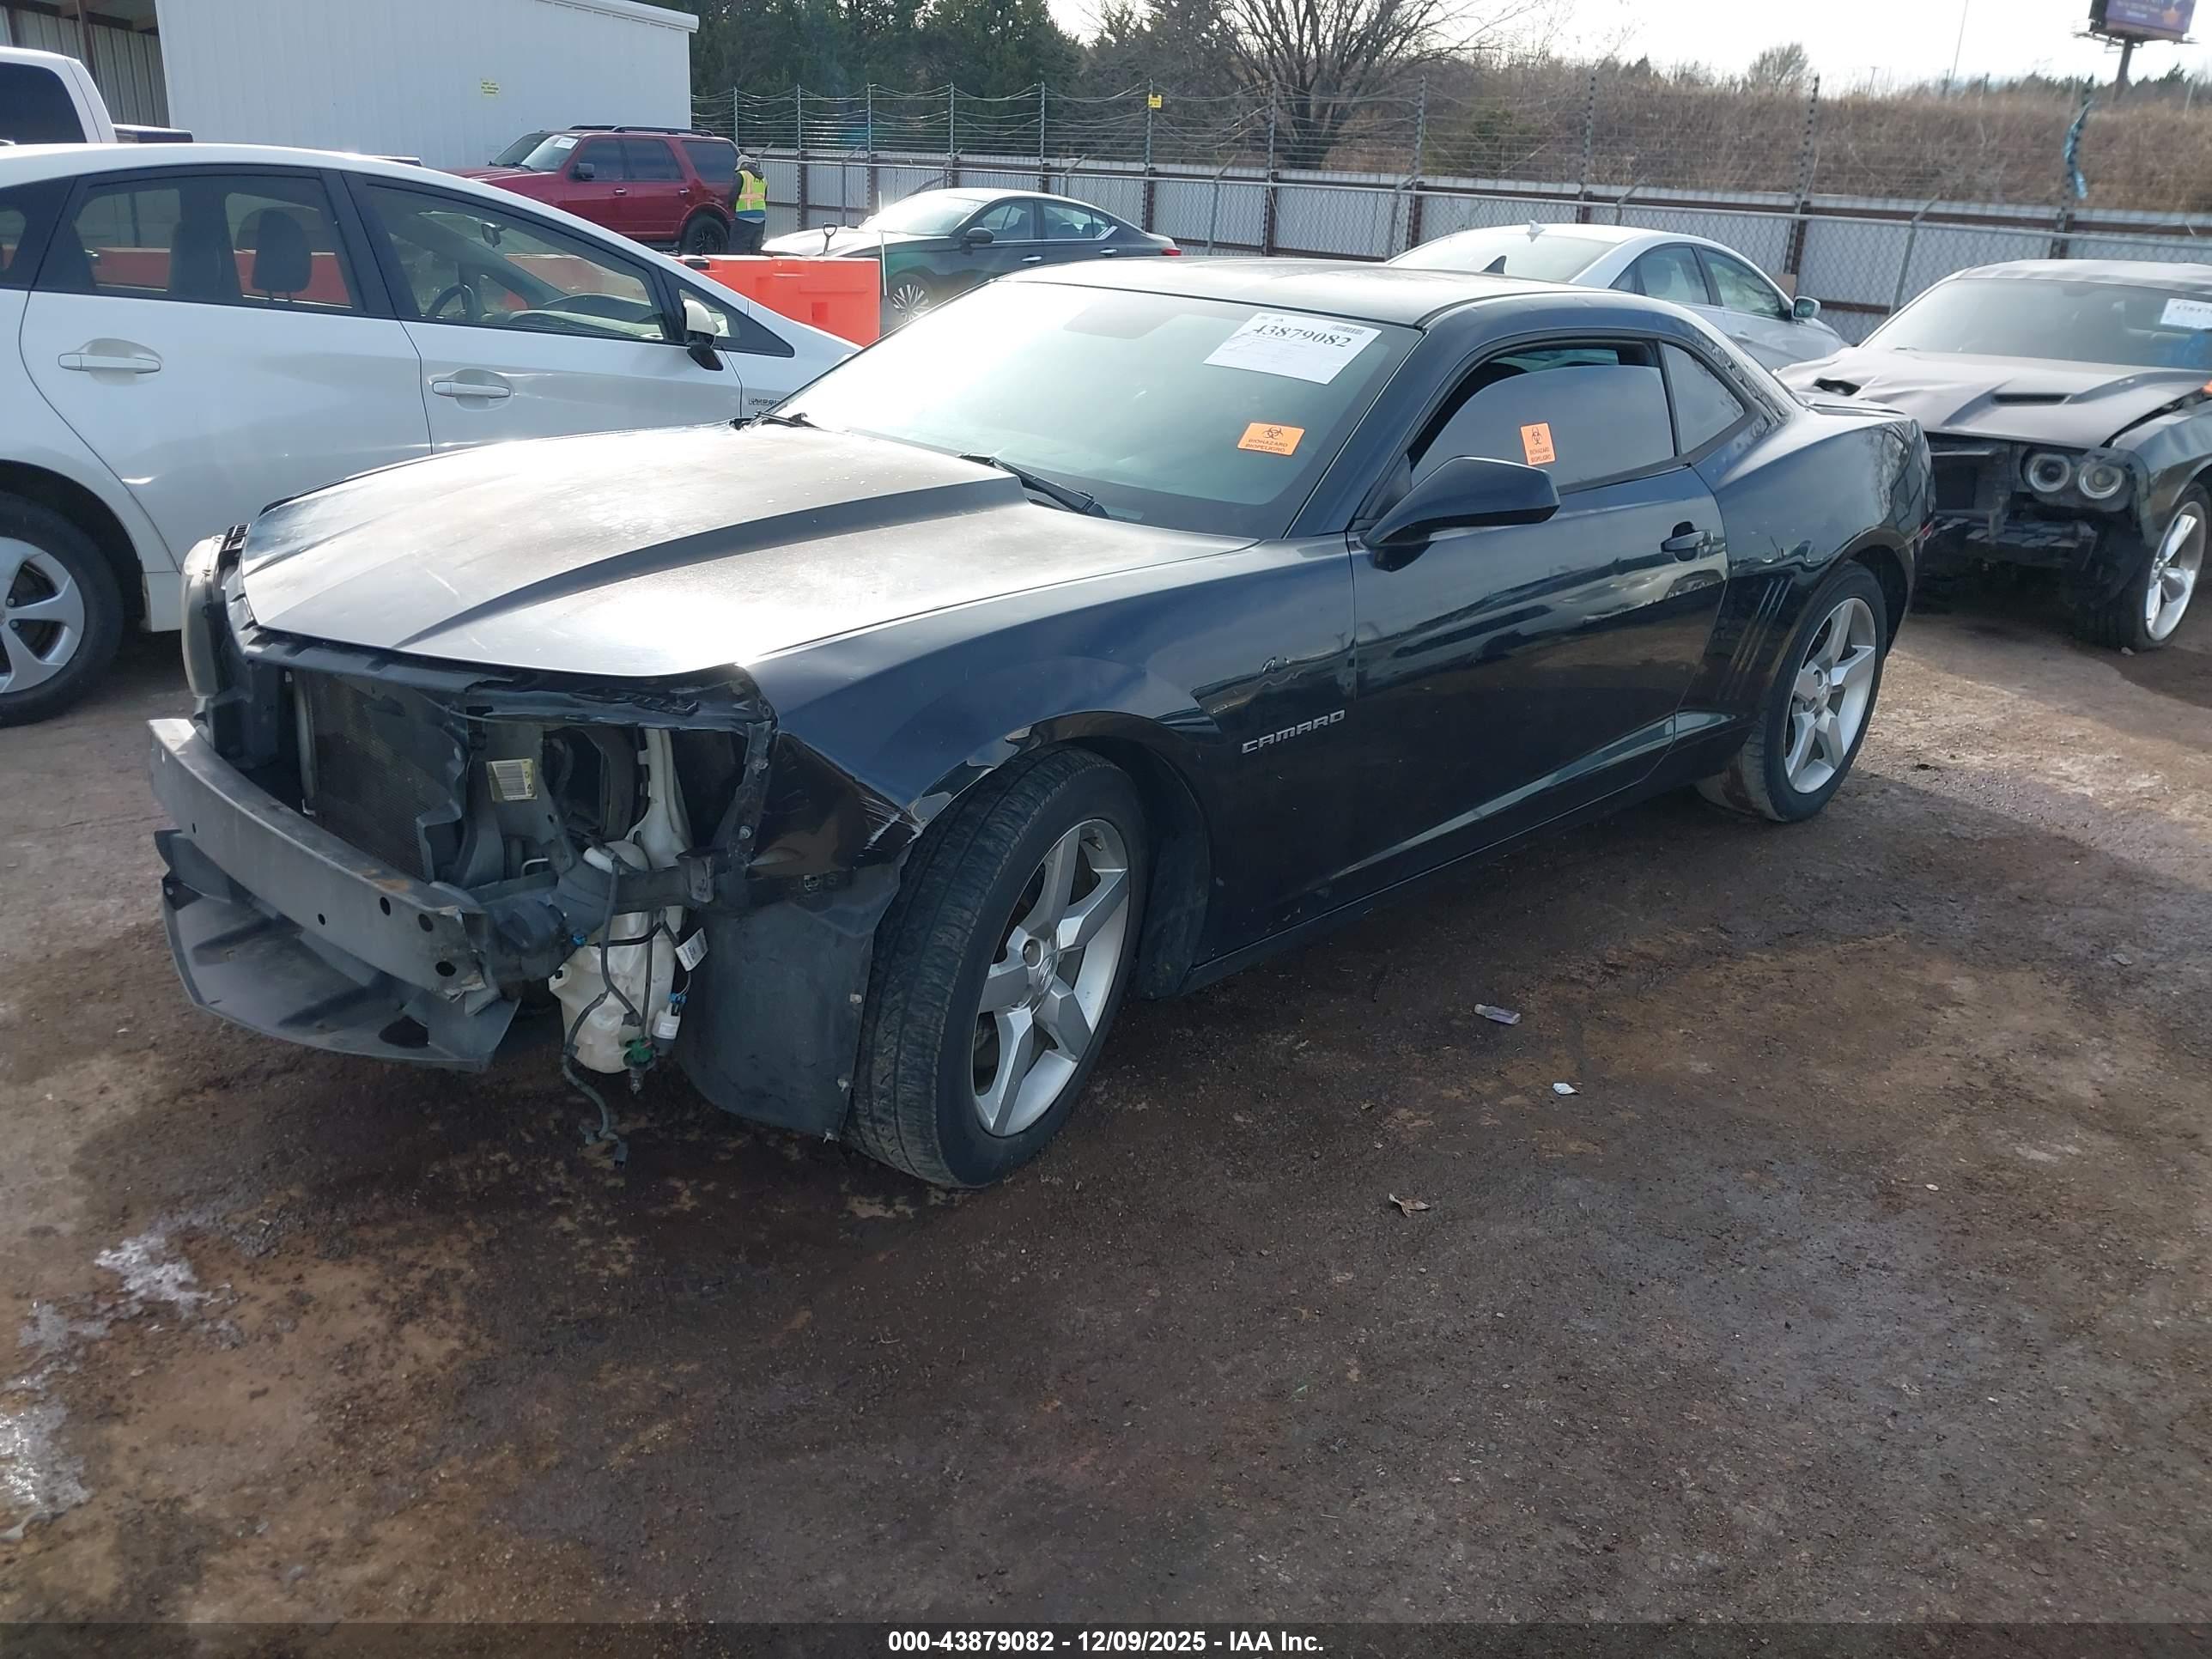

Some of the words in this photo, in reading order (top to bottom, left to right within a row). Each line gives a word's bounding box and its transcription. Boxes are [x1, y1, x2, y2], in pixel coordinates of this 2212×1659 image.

[1253, 325, 1352, 347] 43879082
[1249, 439, 1288, 447] BIOHAZARD
[1242, 709, 1346, 754] CAMARO
